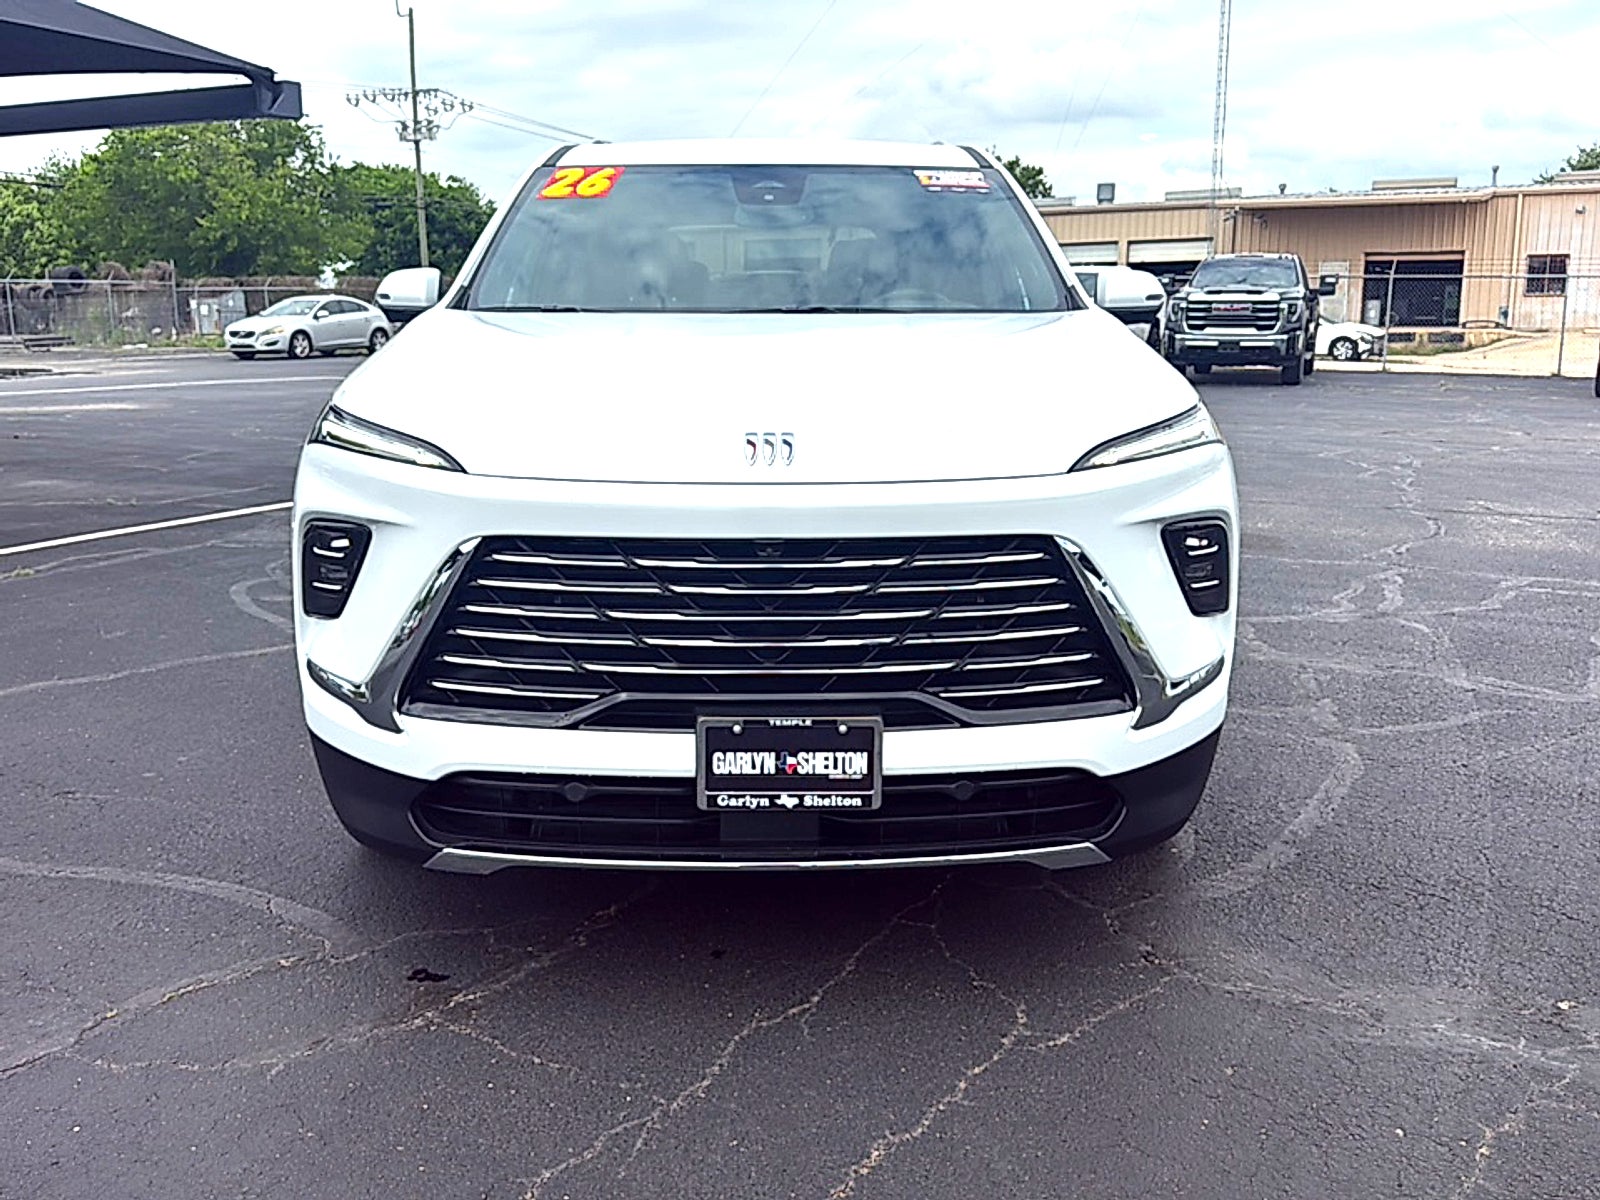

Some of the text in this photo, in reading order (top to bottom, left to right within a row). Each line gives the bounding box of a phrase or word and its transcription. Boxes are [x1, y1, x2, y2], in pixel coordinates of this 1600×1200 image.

[541, 167, 616, 198] 26
[768, 718, 813, 727] TEMPLE
[712, 751, 868, 775] GARLYN SHELTON
[717, 794, 862, 809] Garlyn Shelton
